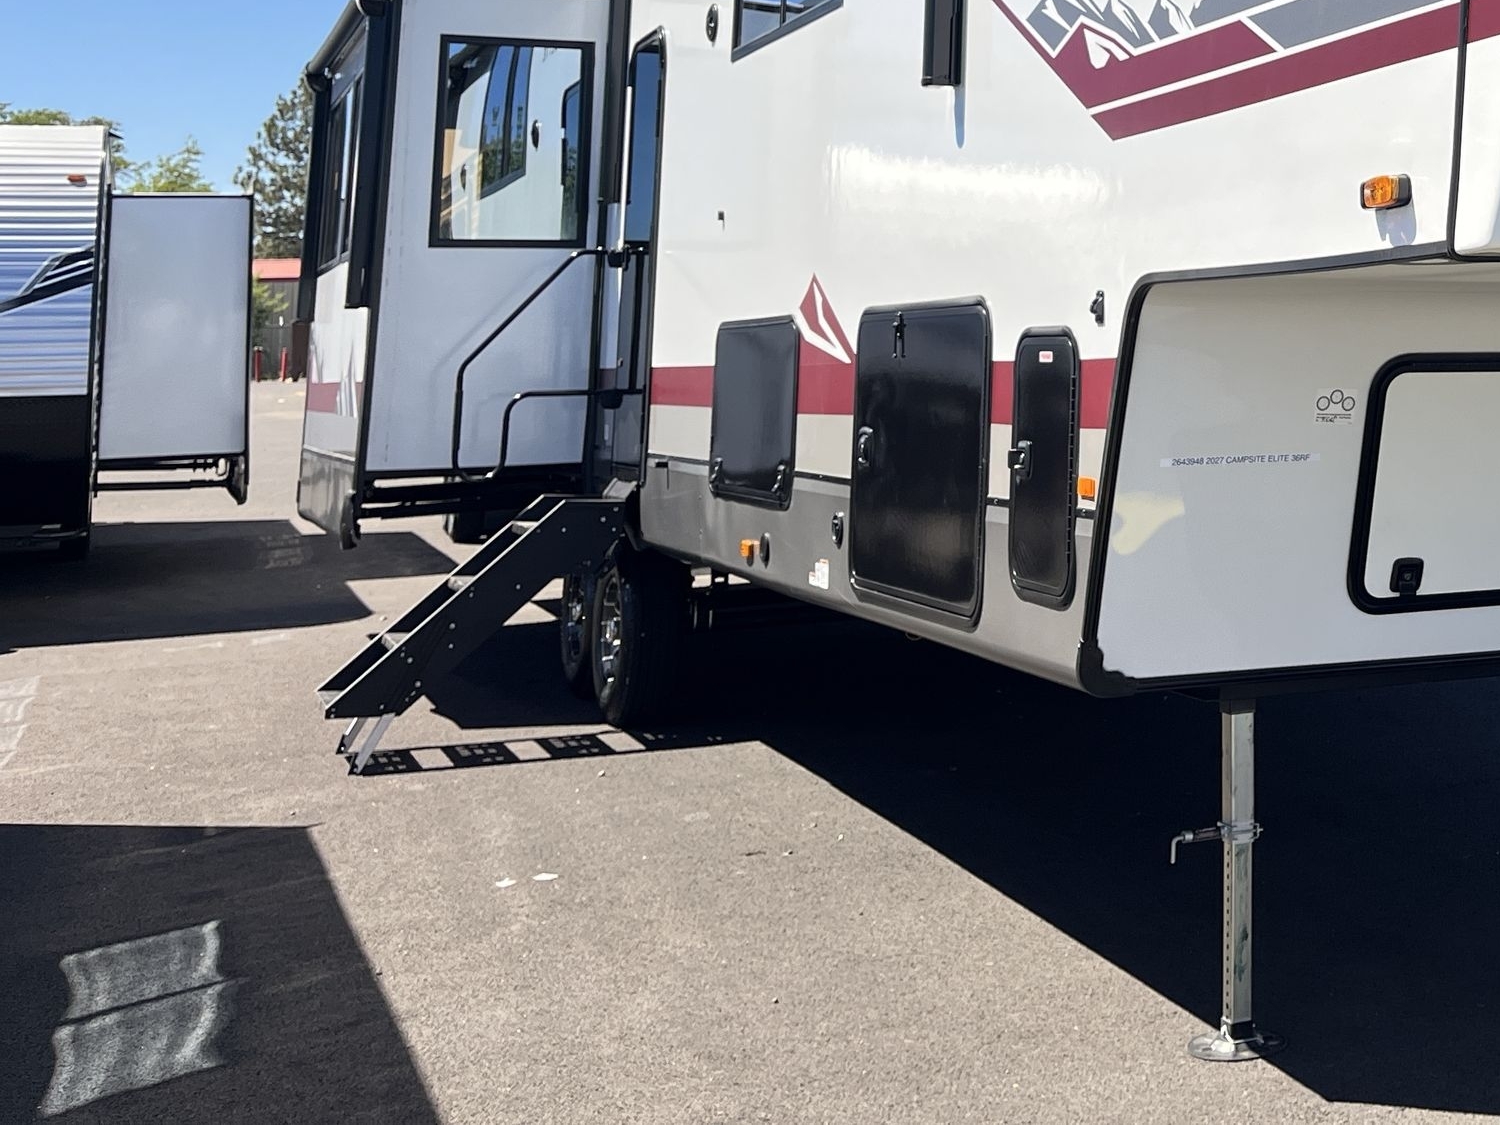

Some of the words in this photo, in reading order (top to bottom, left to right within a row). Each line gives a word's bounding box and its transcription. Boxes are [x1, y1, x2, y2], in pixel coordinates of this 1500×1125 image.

[1206, 456, 1225, 465] 2027
[1225, 455, 1266, 465] CAMPSITE
[1267, 454, 1290, 463] ELITE
